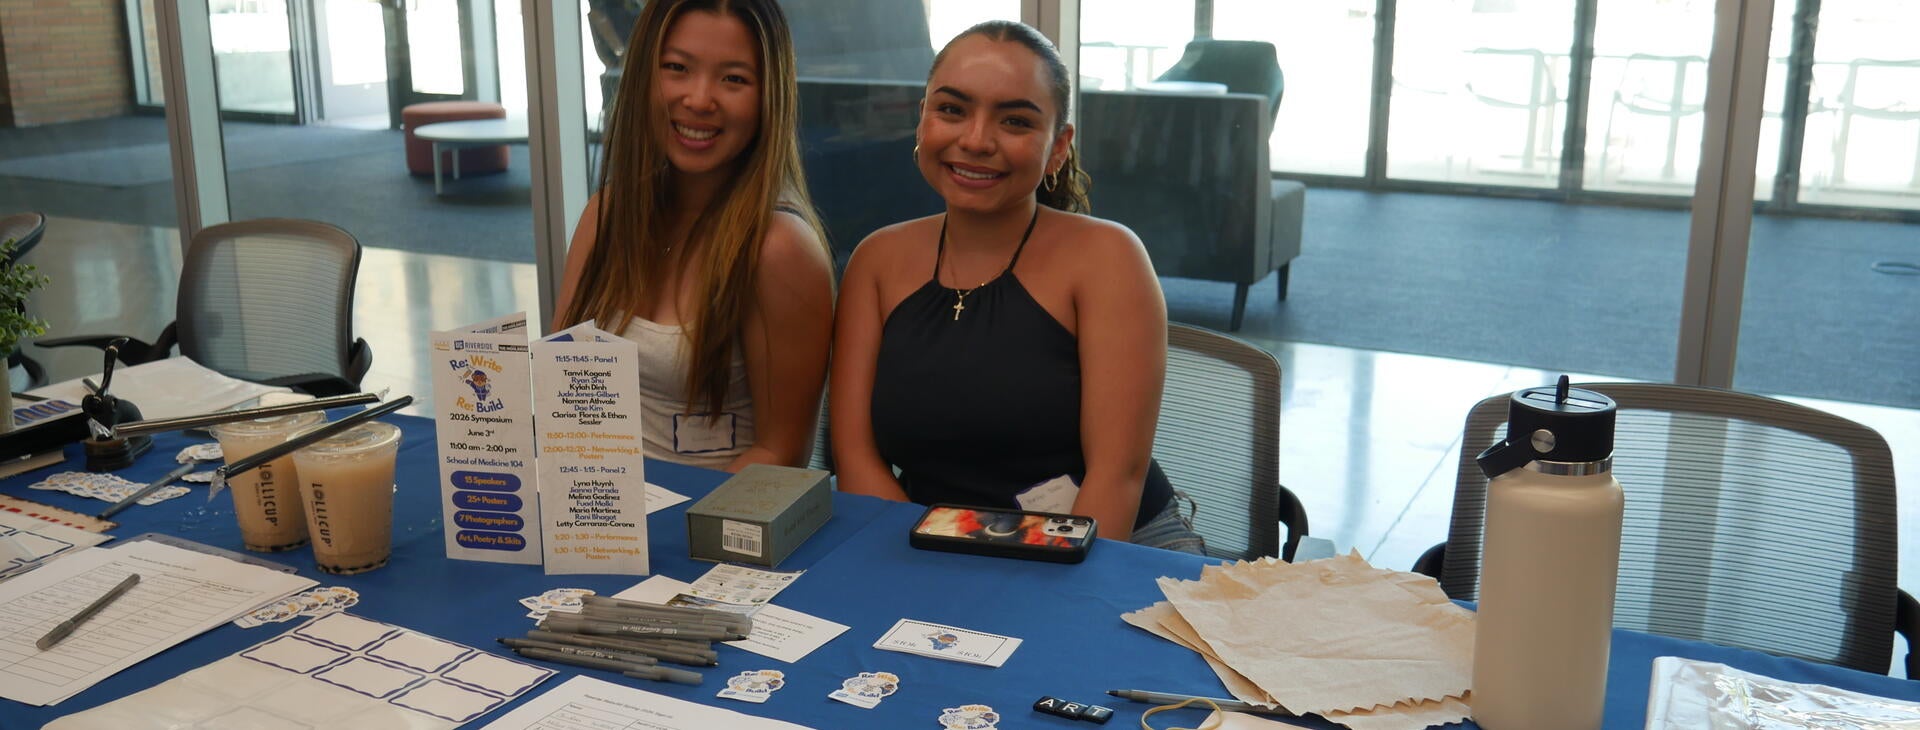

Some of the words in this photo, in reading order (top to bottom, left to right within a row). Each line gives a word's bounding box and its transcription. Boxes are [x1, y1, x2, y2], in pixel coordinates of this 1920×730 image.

[465, 342, 493, 350] RIVERSIDE
[449, 359, 469, 371] Re:
[470, 355, 503, 373] Write
[594, 355, 613, 363] Panel
[584, 370, 611, 378] Koganti
[571, 377, 590, 385] Ryan
[456, 397, 474, 411] Re:
[476, 398, 504, 413] Build
[450, 412, 470, 421] 2026
[471, 414, 513, 424] Symposium
[450, 442, 467, 450] 11:00
[504, 447, 517, 455] pm
[446, 456, 469, 464] School
[470, 457, 477, 465] of
[478, 458, 509, 467] Medicine
[474, 476, 507, 486] Speakers
[482, 496, 507, 504] Posters
[312, 482, 332, 546] LOLLICUP
